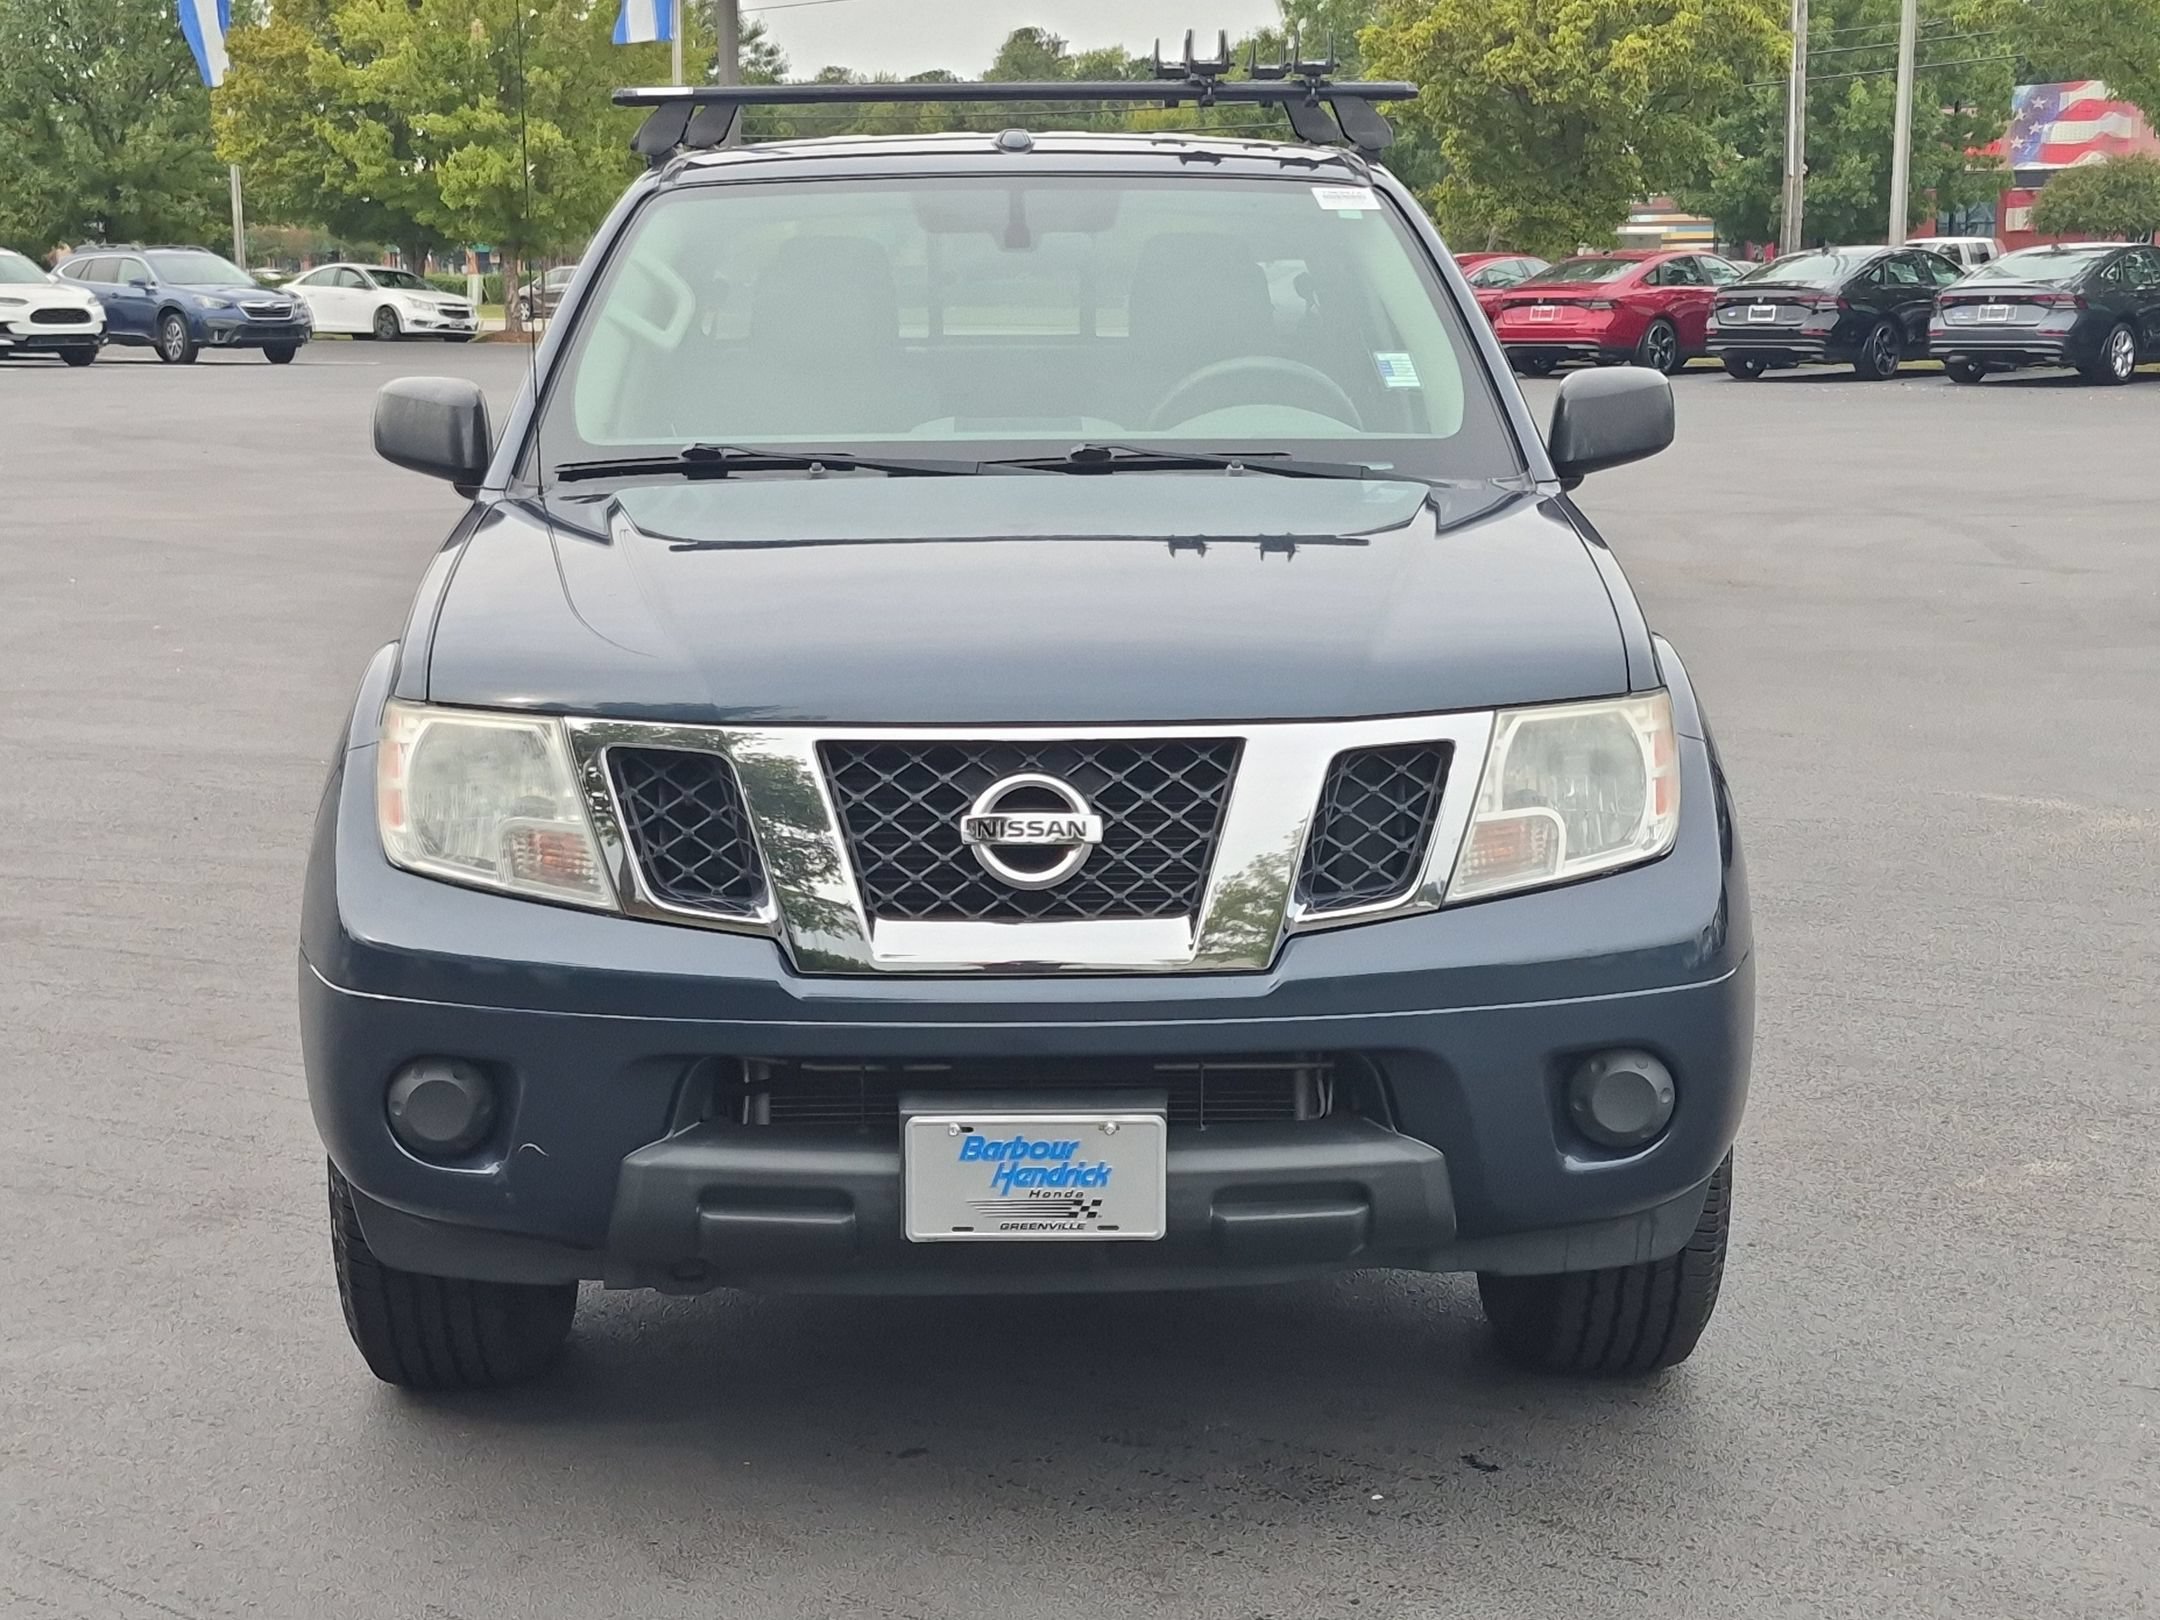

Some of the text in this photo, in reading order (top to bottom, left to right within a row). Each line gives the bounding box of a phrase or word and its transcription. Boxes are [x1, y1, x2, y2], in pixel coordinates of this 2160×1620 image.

[977, 820, 1087, 838] NISSAN
[959, 1135, 1081, 1161] Barbour
[990, 1161, 1112, 1196] Hendrick
[1029, 1189, 1084, 1198] Honda
[1000, 1222, 1086, 1230] GREENVILLE
